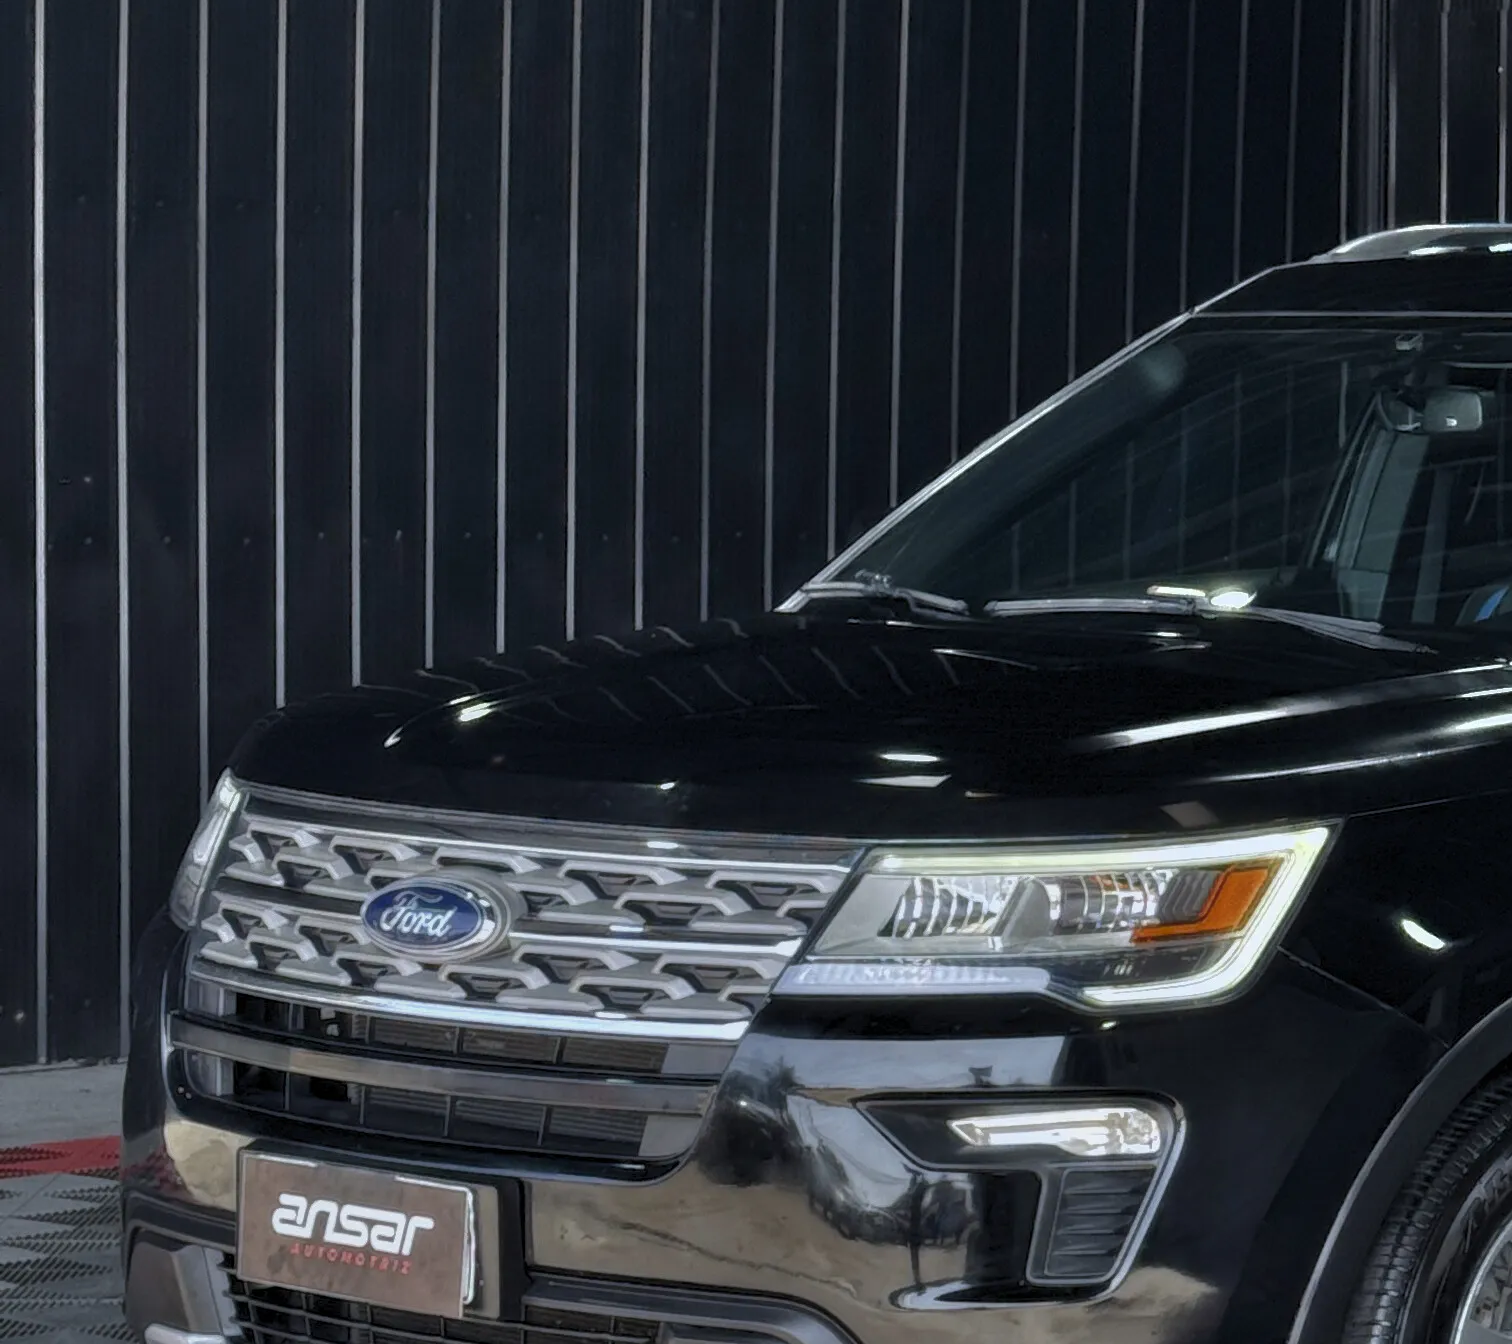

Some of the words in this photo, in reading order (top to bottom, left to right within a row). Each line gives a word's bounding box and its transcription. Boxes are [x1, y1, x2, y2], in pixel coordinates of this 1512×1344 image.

[380, 890, 458, 938] Ford
[271, 1193, 435, 1256] ansar
[289, 1242, 413, 1275] AUTOMOTRIZ
